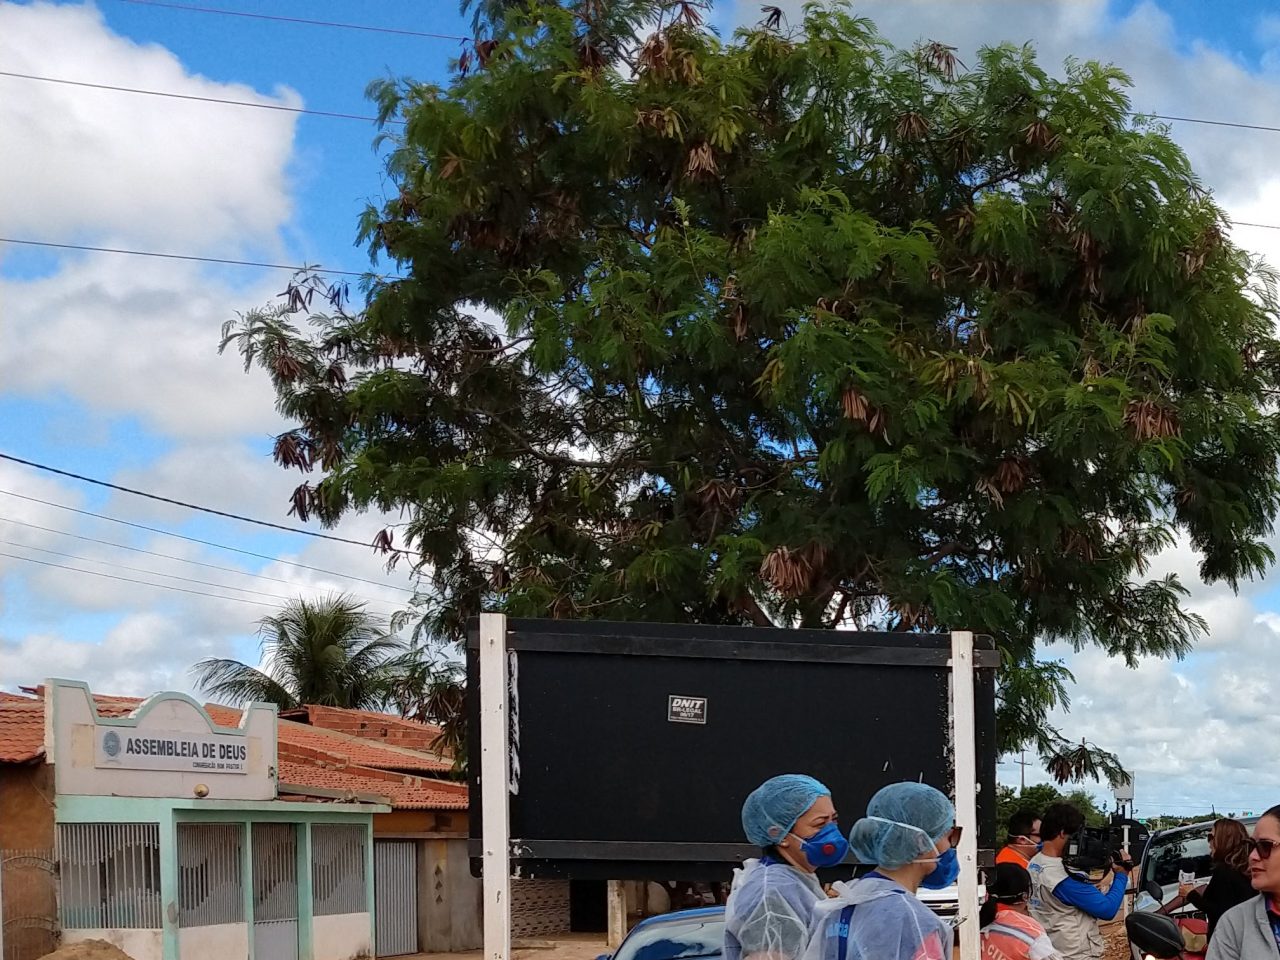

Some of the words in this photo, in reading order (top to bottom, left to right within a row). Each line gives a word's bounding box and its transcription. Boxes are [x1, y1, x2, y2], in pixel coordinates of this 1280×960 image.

[672, 699, 704, 708] DNIT
[126, 738, 199, 758] ASSEMBLEIA
[202, 743, 216, 759] DE
[219, 744, 246, 760] DEUS
